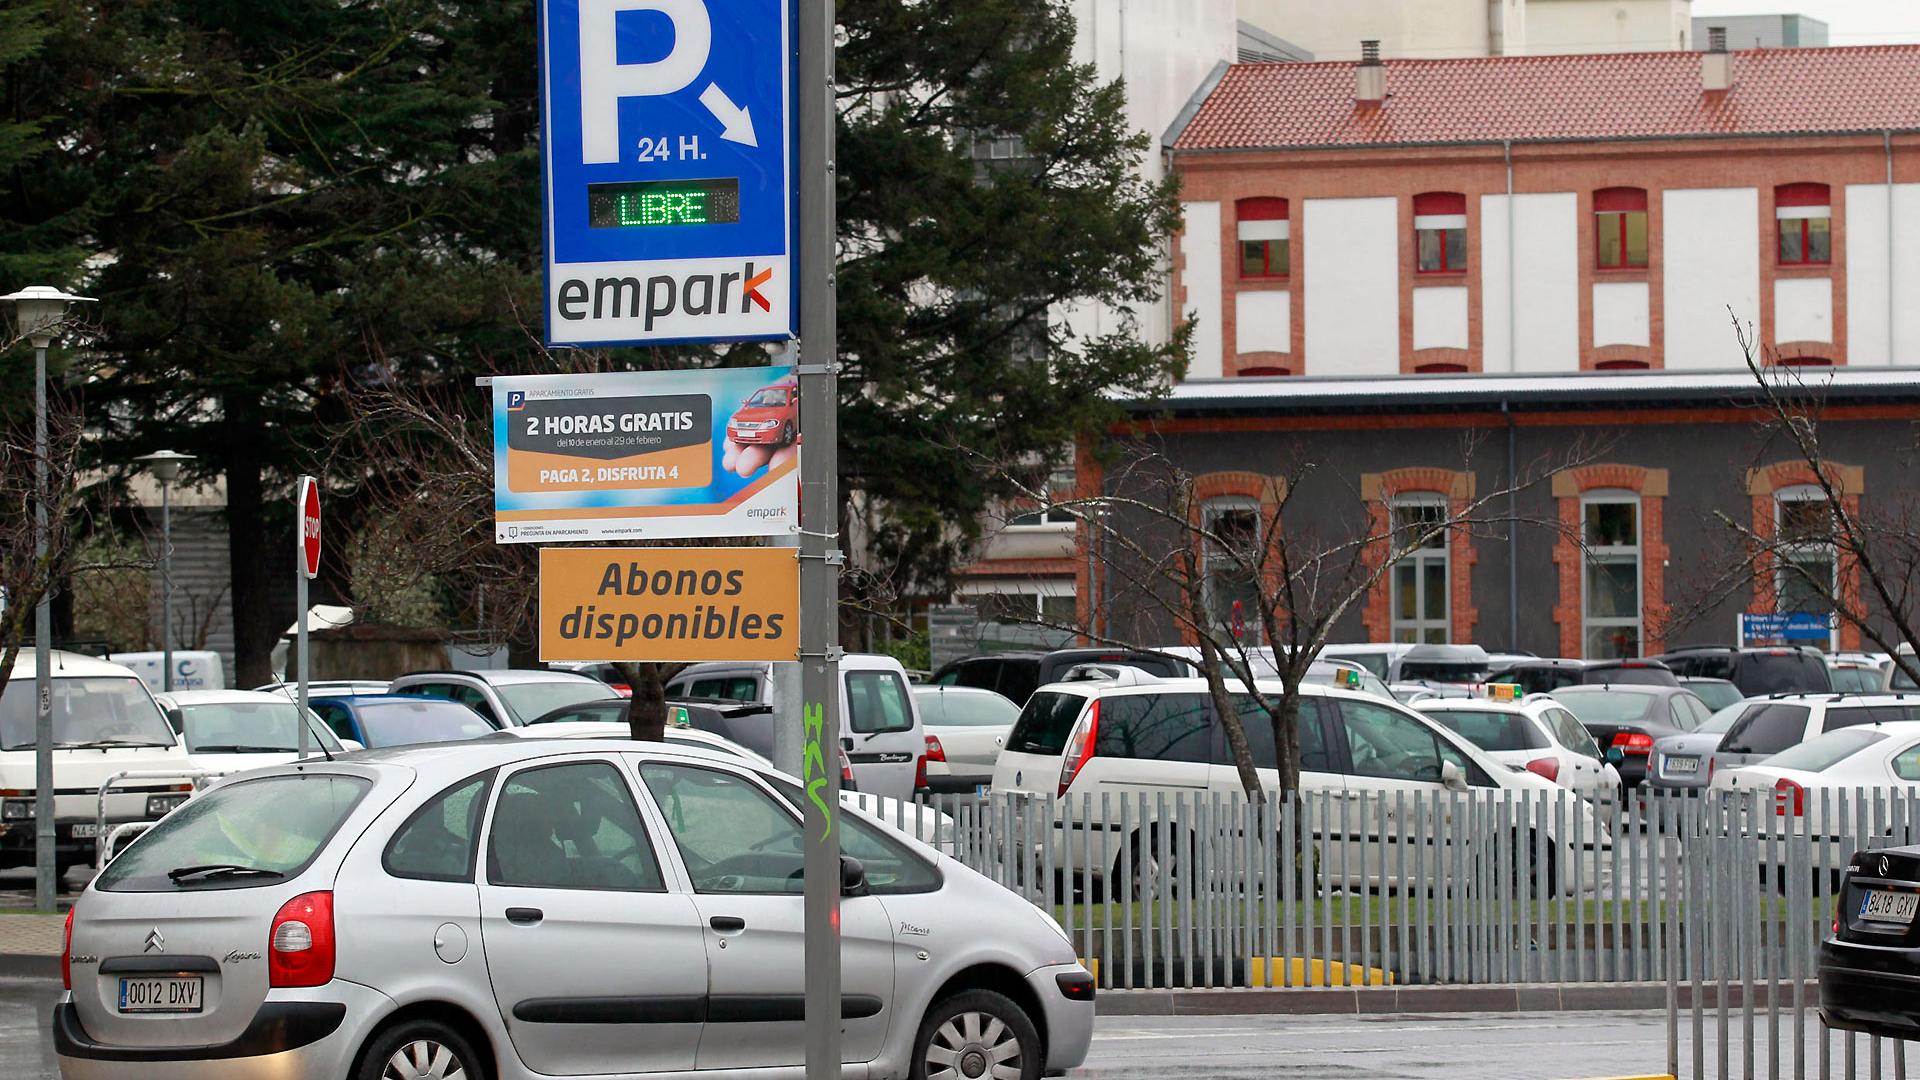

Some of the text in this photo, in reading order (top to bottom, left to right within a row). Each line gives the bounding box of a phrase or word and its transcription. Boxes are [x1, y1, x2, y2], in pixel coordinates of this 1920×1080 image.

[578, 0, 712, 165] P
[638, 135, 707, 162] 24 H.
[620, 191, 706, 226] LIBRE
[557, 262, 772, 332] empark
[574, 387, 595, 396] GRATIS
[527, 411, 693, 436] 2 HORAS GRATIS
[557, 438, 568, 448] del
[575, 437, 585, 447] de
[585, 438, 605, 447] enero
[606, 436, 614, 446] al
[614, 436, 625, 446] 29
[625, 436, 636, 445] de
[636, 435, 662, 445] febrero
[540, 465, 680, 484] PAGA 2, DISFRUTA 4
[746, 506, 787, 520] empark
[305, 515, 320, 540] STOP
[597, 562, 744, 596] Abonos
[559, 605, 784, 648] disponibles
[1868, 893, 1917, 916] 8418 GXV
[129, 981, 196, 1005] 0012 DXV
